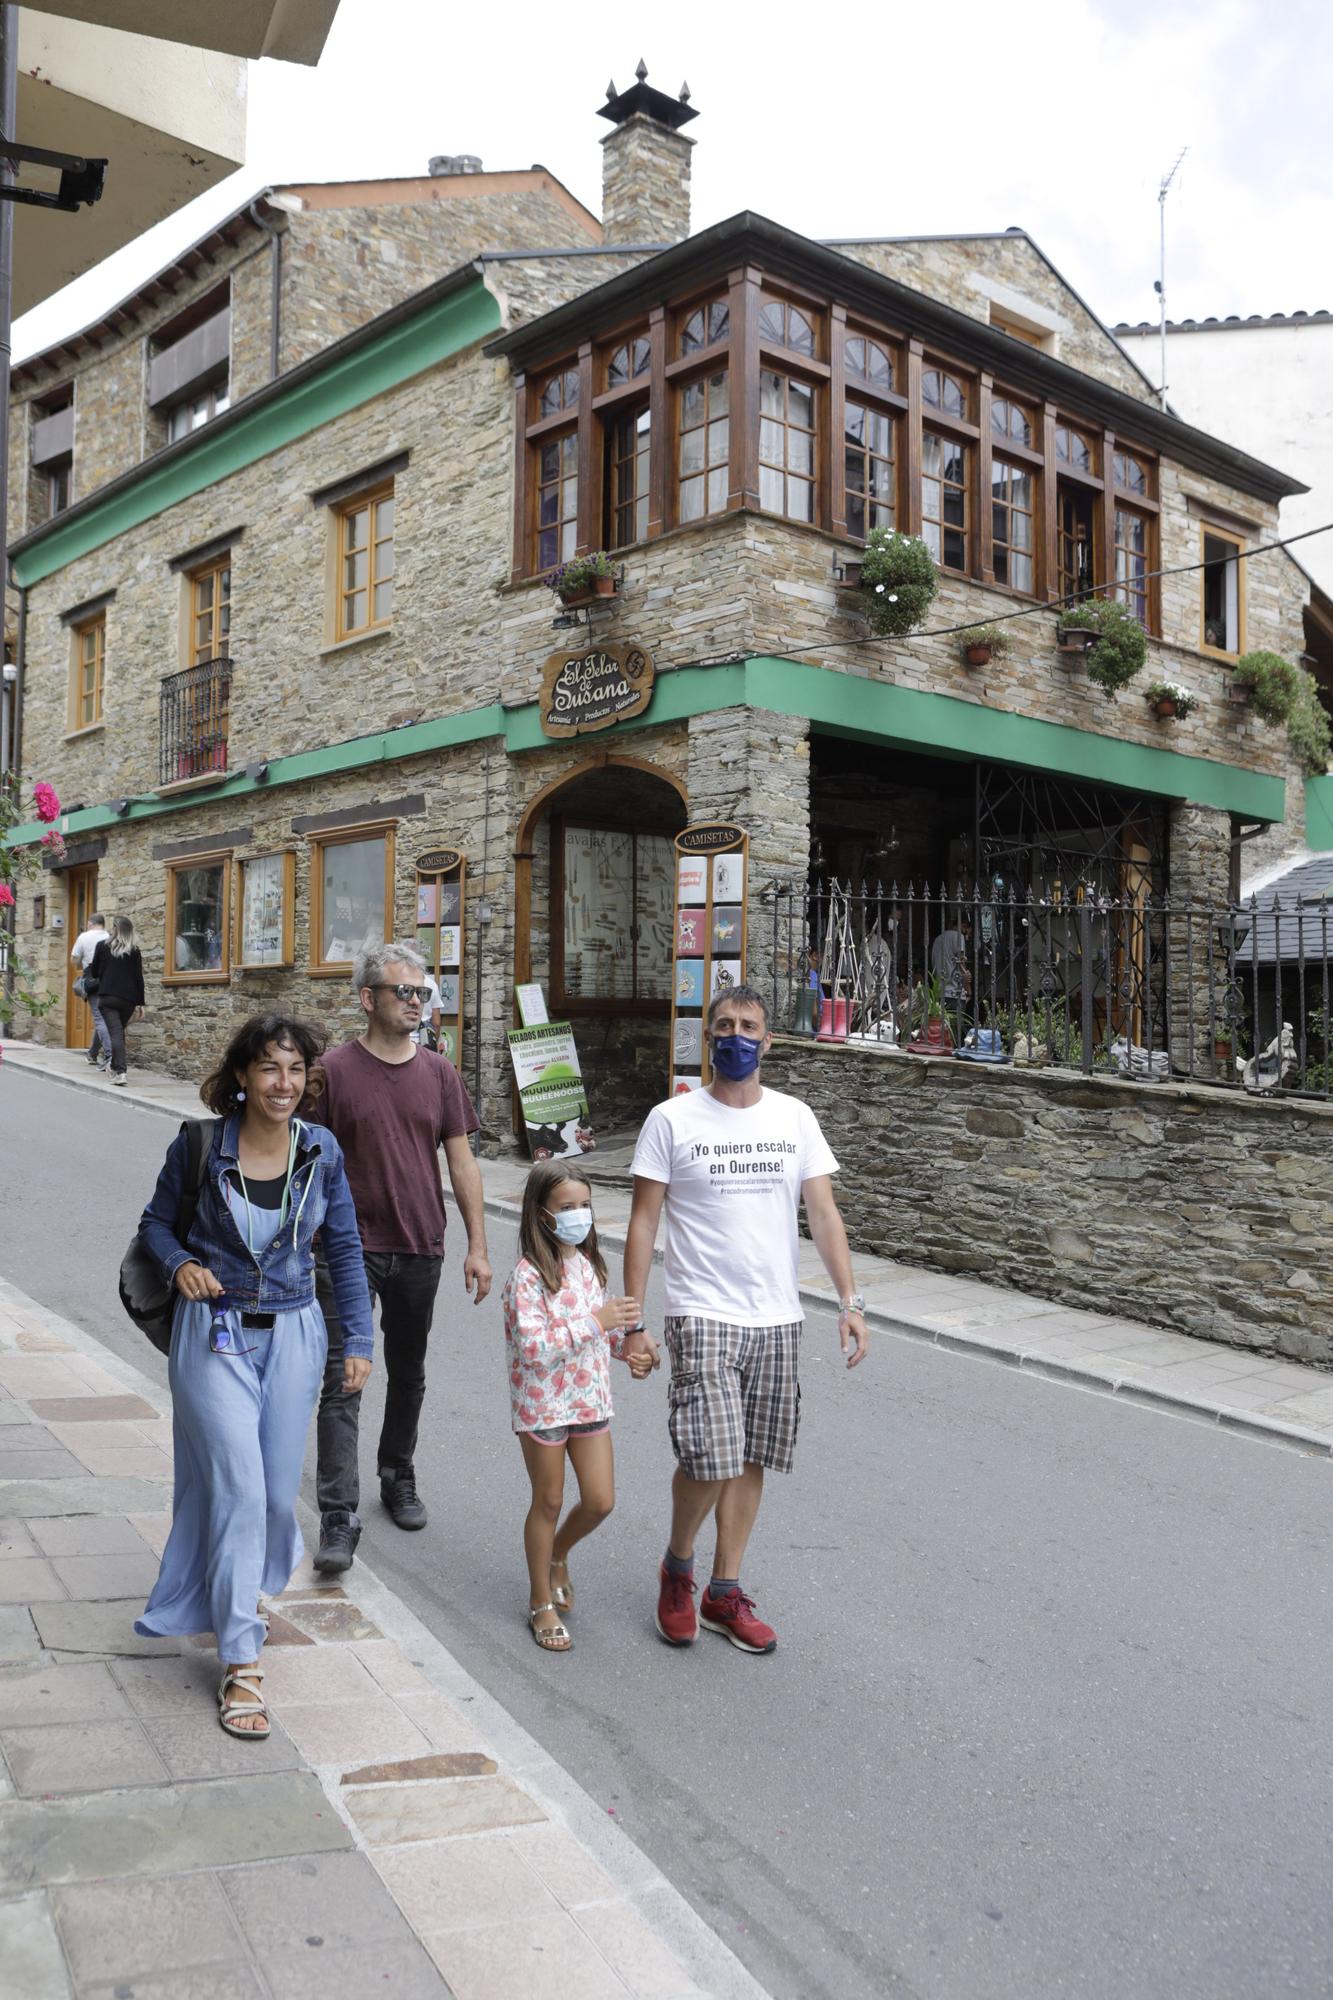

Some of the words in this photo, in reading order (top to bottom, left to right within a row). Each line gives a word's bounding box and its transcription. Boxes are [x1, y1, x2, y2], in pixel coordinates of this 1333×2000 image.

[564, 660, 584, 686] El
[585, 654, 619, 679] Telar
[579, 677, 592, 691] de
[555, 679, 630, 711] Susana
[585, 707, 611, 721] Productos
[615, 691, 641, 711] Naturales
[684, 830, 735, 847] CAMISETAS
[420, 853, 454, 867] CAMISETAS
[508, 1031, 537, 1044] HELADOS
[537, 1025, 572, 1039] ARTESANOS
[522, 1087, 585, 1104] BUUEENOOSS
[691, 1143, 709, 1160] ¡Yo
[714, 1142, 752, 1157] quiero
[757, 1140, 796, 1154] escalar
[710, 1164, 725, 1174] en
[730, 1159, 784, 1174] Ourense!
